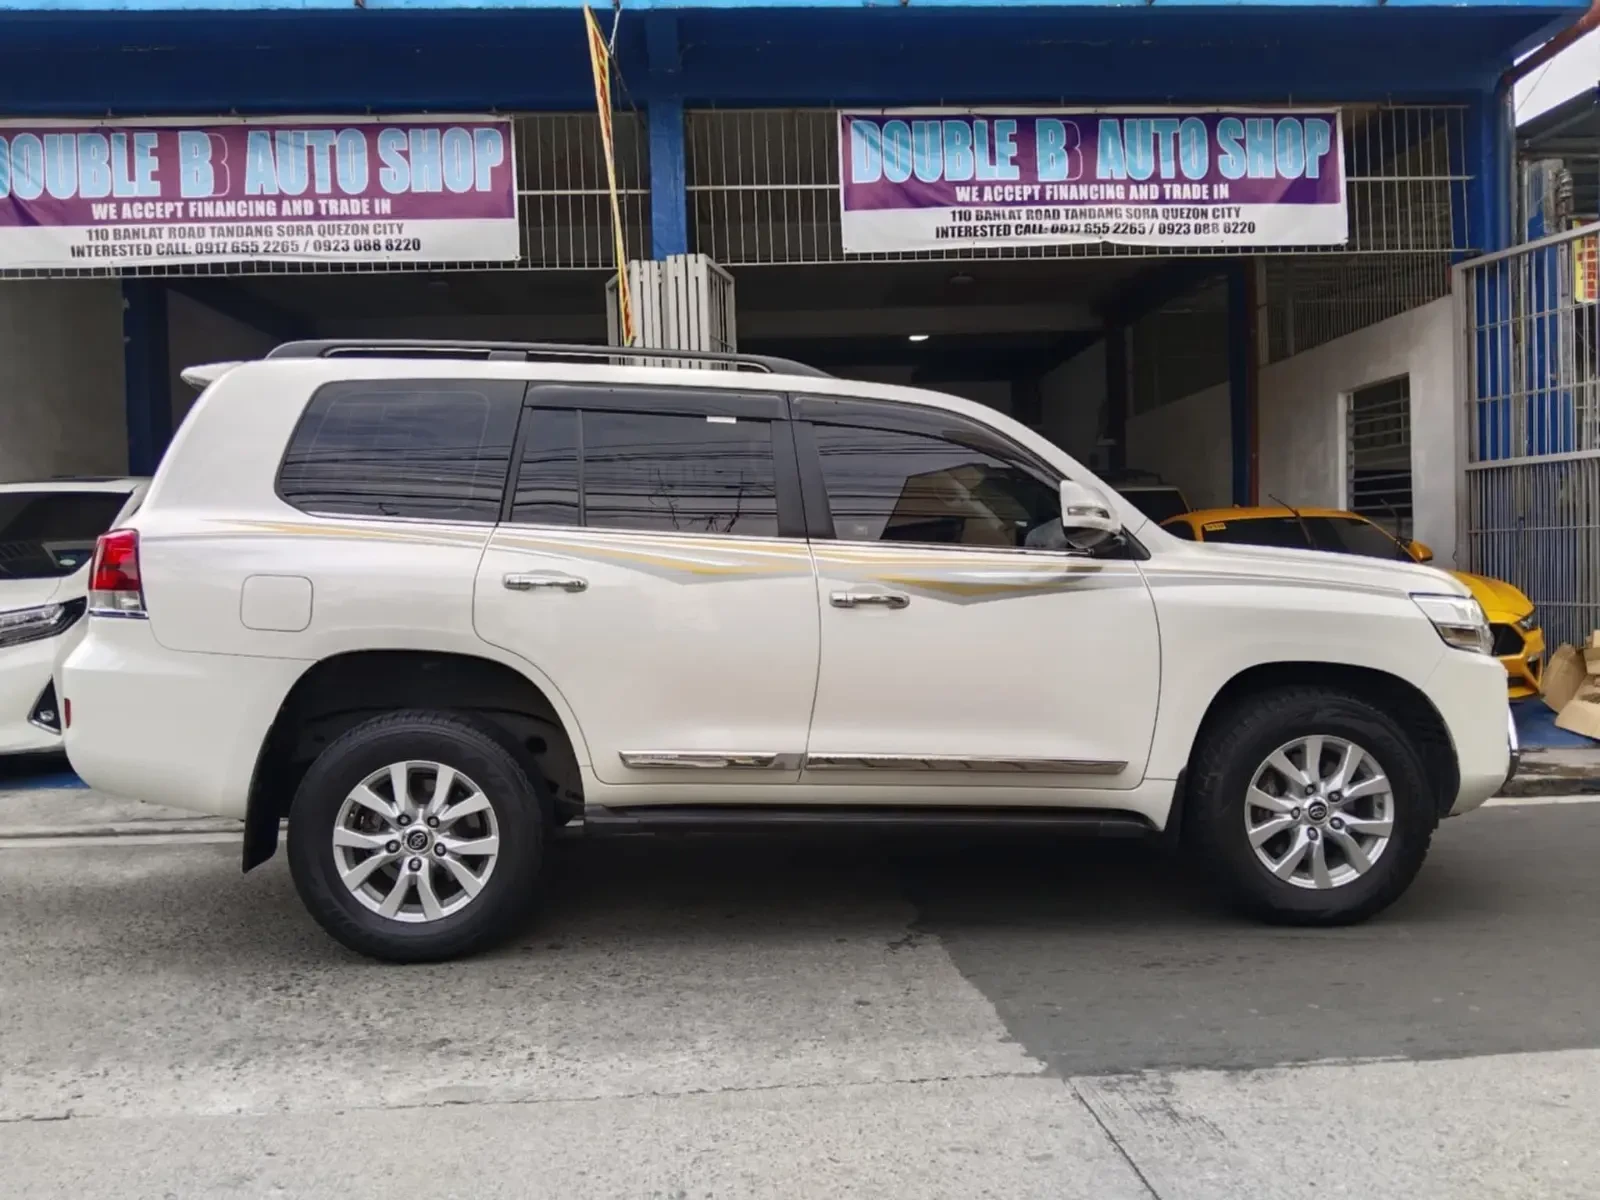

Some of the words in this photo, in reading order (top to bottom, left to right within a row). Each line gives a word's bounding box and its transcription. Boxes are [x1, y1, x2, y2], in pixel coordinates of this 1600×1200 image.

[850, 119, 1021, 184] DOUBLE
[1096, 117, 1209, 181] AUTO
[1216, 117, 1331, 180] SHOP
[245, 128, 369, 197] AUTO
[377, 127, 504, 195] SHOP
[955, 186, 981, 201] WE
[983, 185, 1043, 201] ACCEPT
[1046, 184, 1125, 201] FINANCING
[1129, 183, 1159, 200] AND
[1163, 183, 1209, 200] TRADE
[1213, 183, 1230, 199] IN
[92, 203, 118, 220] WE
[122, 201, 185, 220] ACCEPT
[188, 200, 277, 218] FINANCING
[281, 199, 315, 217] AND
[319, 199, 370, 216] TRADE
[374, 198, 392, 215] IN
[950, 209, 972, 222] 110
[975, 208, 1023, 222] BANLAT
[1026, 208, 1061, 221] ROAD
[1064, 207, 1123, 221] TANDANG
[1126, 206, 1159, 220] SORA
[1162, 206, 1209, 220] QUEZON
[1211, 206, 1242, 219] CITY
[86, 228, 109, 242] 110
[113, 226, 165, 241] BANLAT
[168, 225, 206, 240] ROAD
[208, 224, 273, 239] TANDANG
[277, 223, 314, 238] SORA
[317, 222, 370, 236] QUEZON
[373, 222, 405, 235] CITY
[935, 224, 1012, 239] INTERESTED
[1050, 222, 1081, 235] 0917
[1084, 222, 1110, 235] 655
[1112, 222, 1146, 235] 2265
[1149, 222, 1155, 235] /
[1158, 222, 1192, 235] 0923
[70, 243, 153, 258] INTERESTED
[156, 242, 192, 257] CALL:
[195, 242, 229, 255] 0917
[231, 241, 260, 254] 655
[263, 239, 300, 253] 2265
[303, 239, 309, 252] /
[313, 238, 350, 252] 0923
[385, 237, 421, 251] 8220
